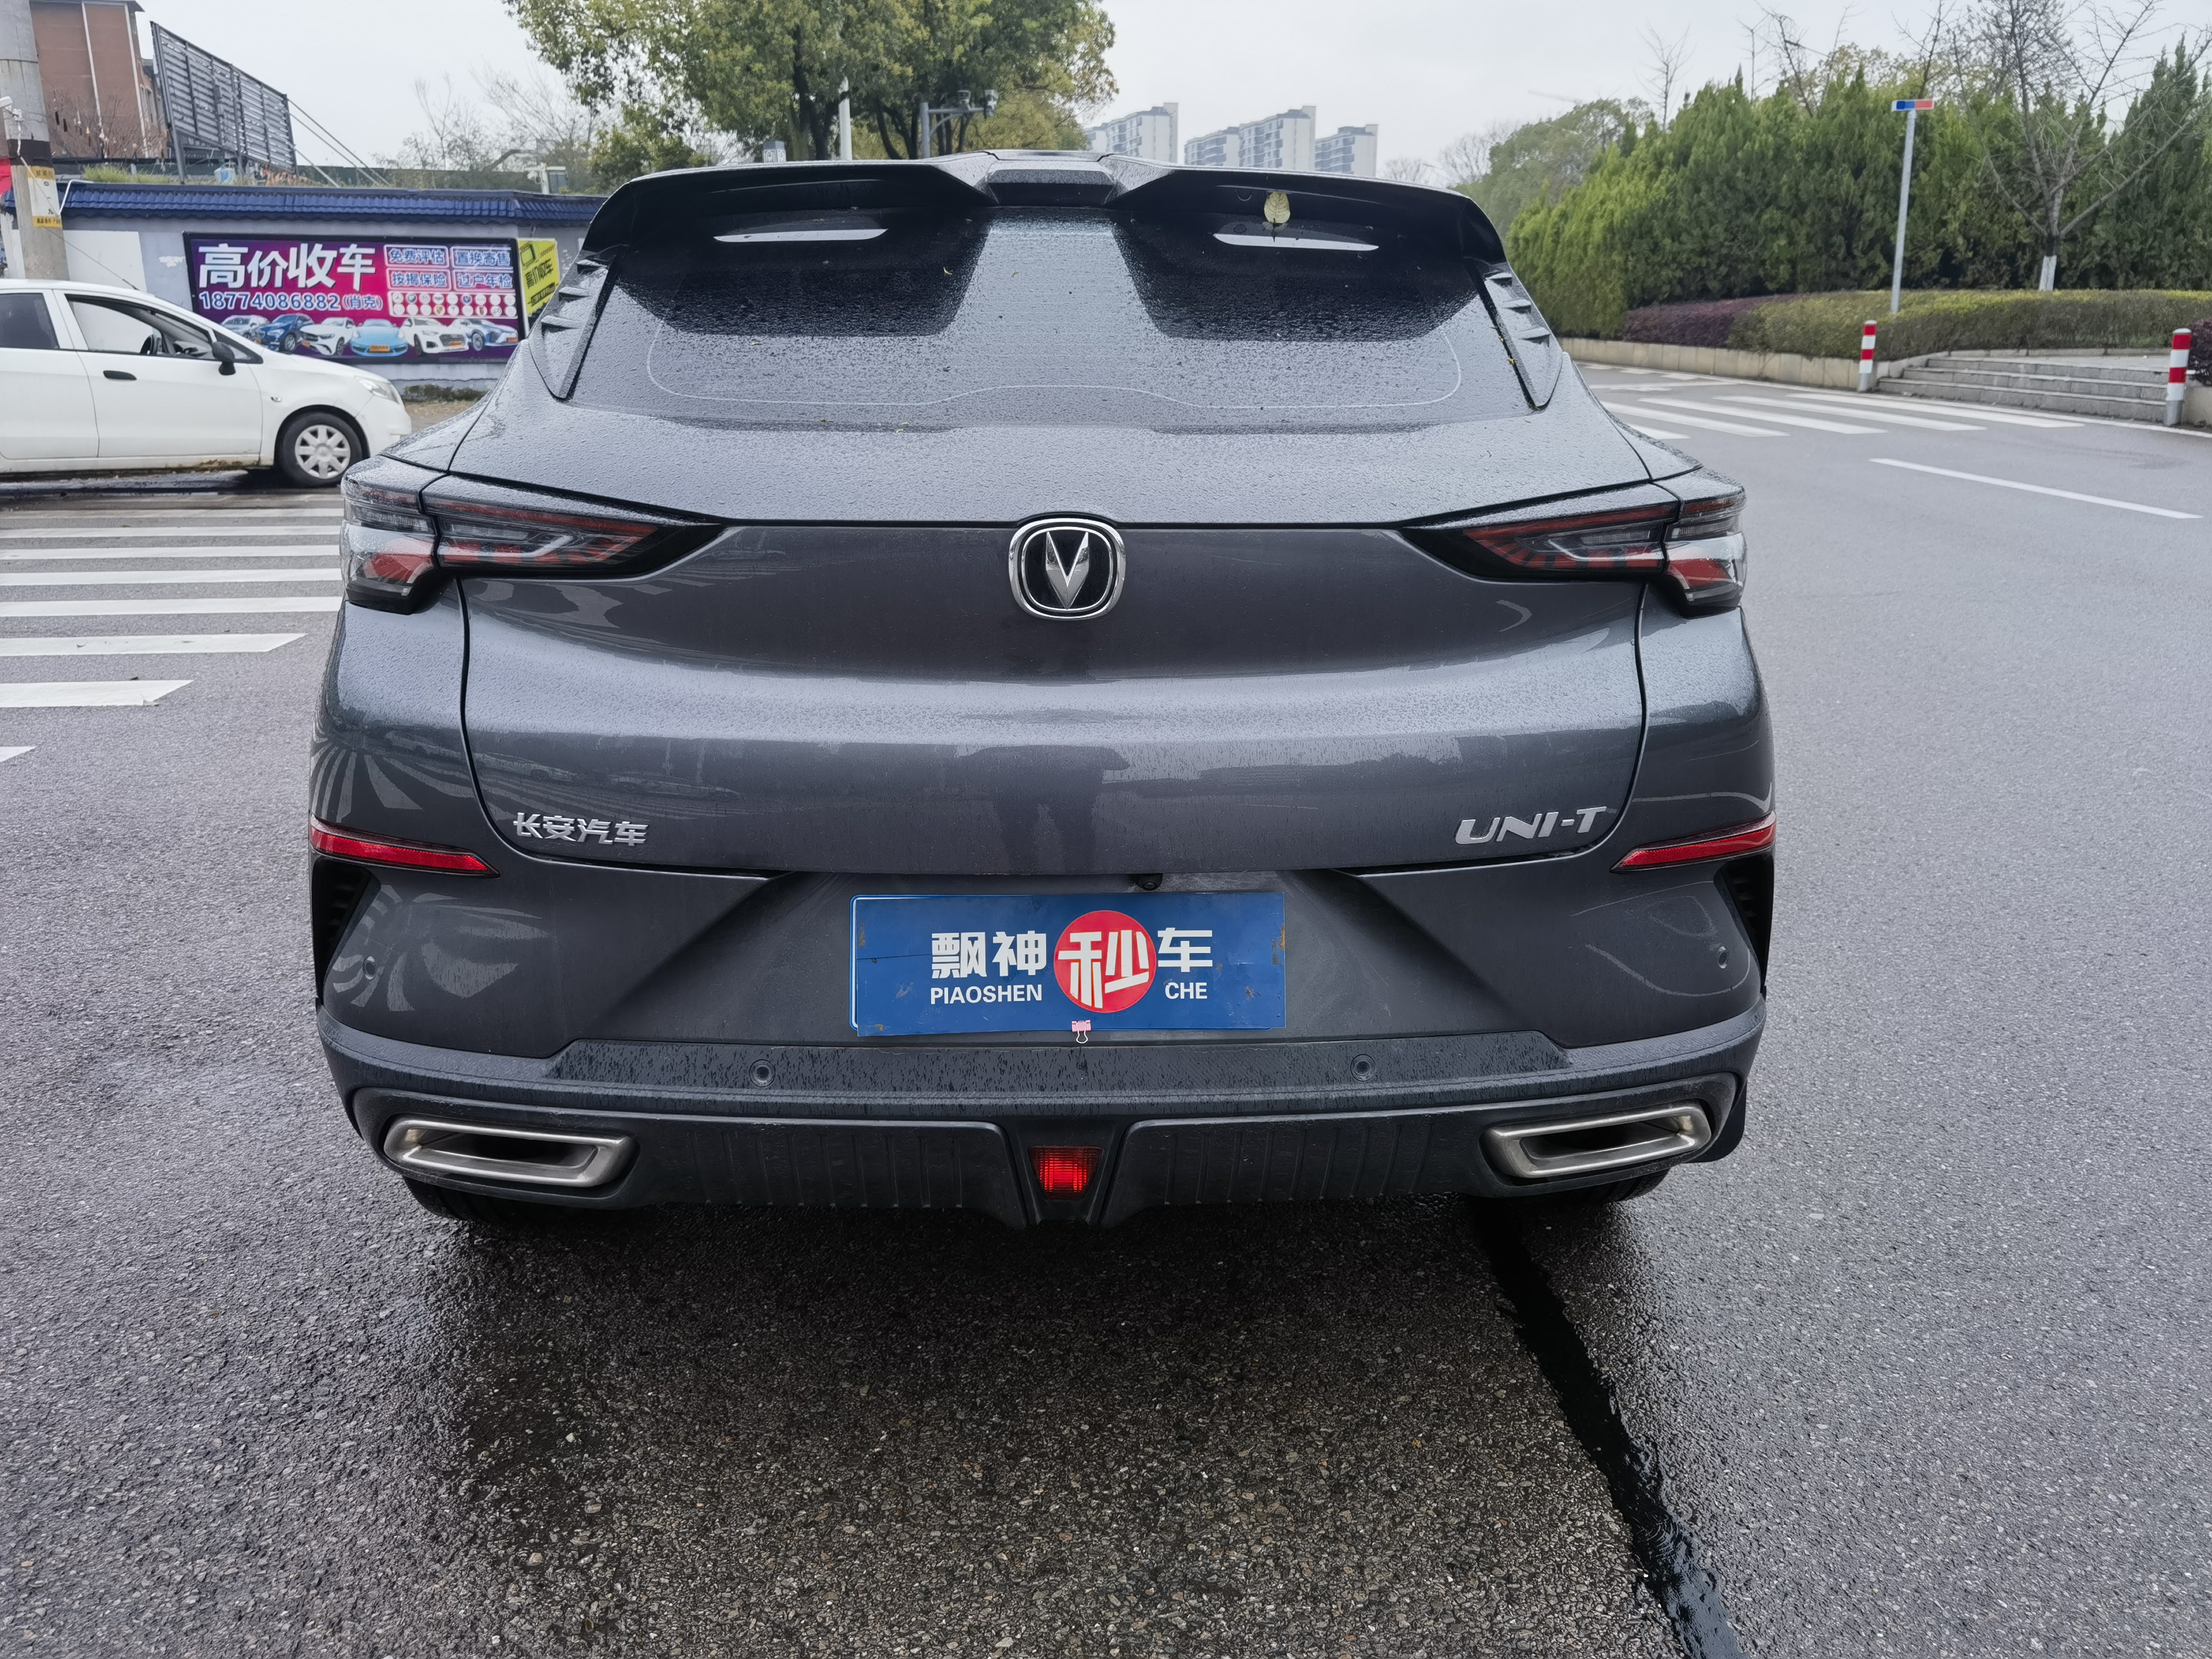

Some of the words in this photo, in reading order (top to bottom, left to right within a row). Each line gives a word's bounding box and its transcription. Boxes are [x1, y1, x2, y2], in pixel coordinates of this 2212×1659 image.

[389, 248, 445, 264] 免费评估
[455, 250, 511, 266] 置换寄售
[199, 243, 376, 292] 高价收车
[391, 271, 448, 287] 按揭保险
[457, 273, 513, 289] 过户年检
[513, 812, 649, 846] 长安汽车
[1455, 806, 1607, 845] UNI-T
[930, 984, 1042, 1004] PIAOSHEN
[1165, 982, 1208, 999] CHE
